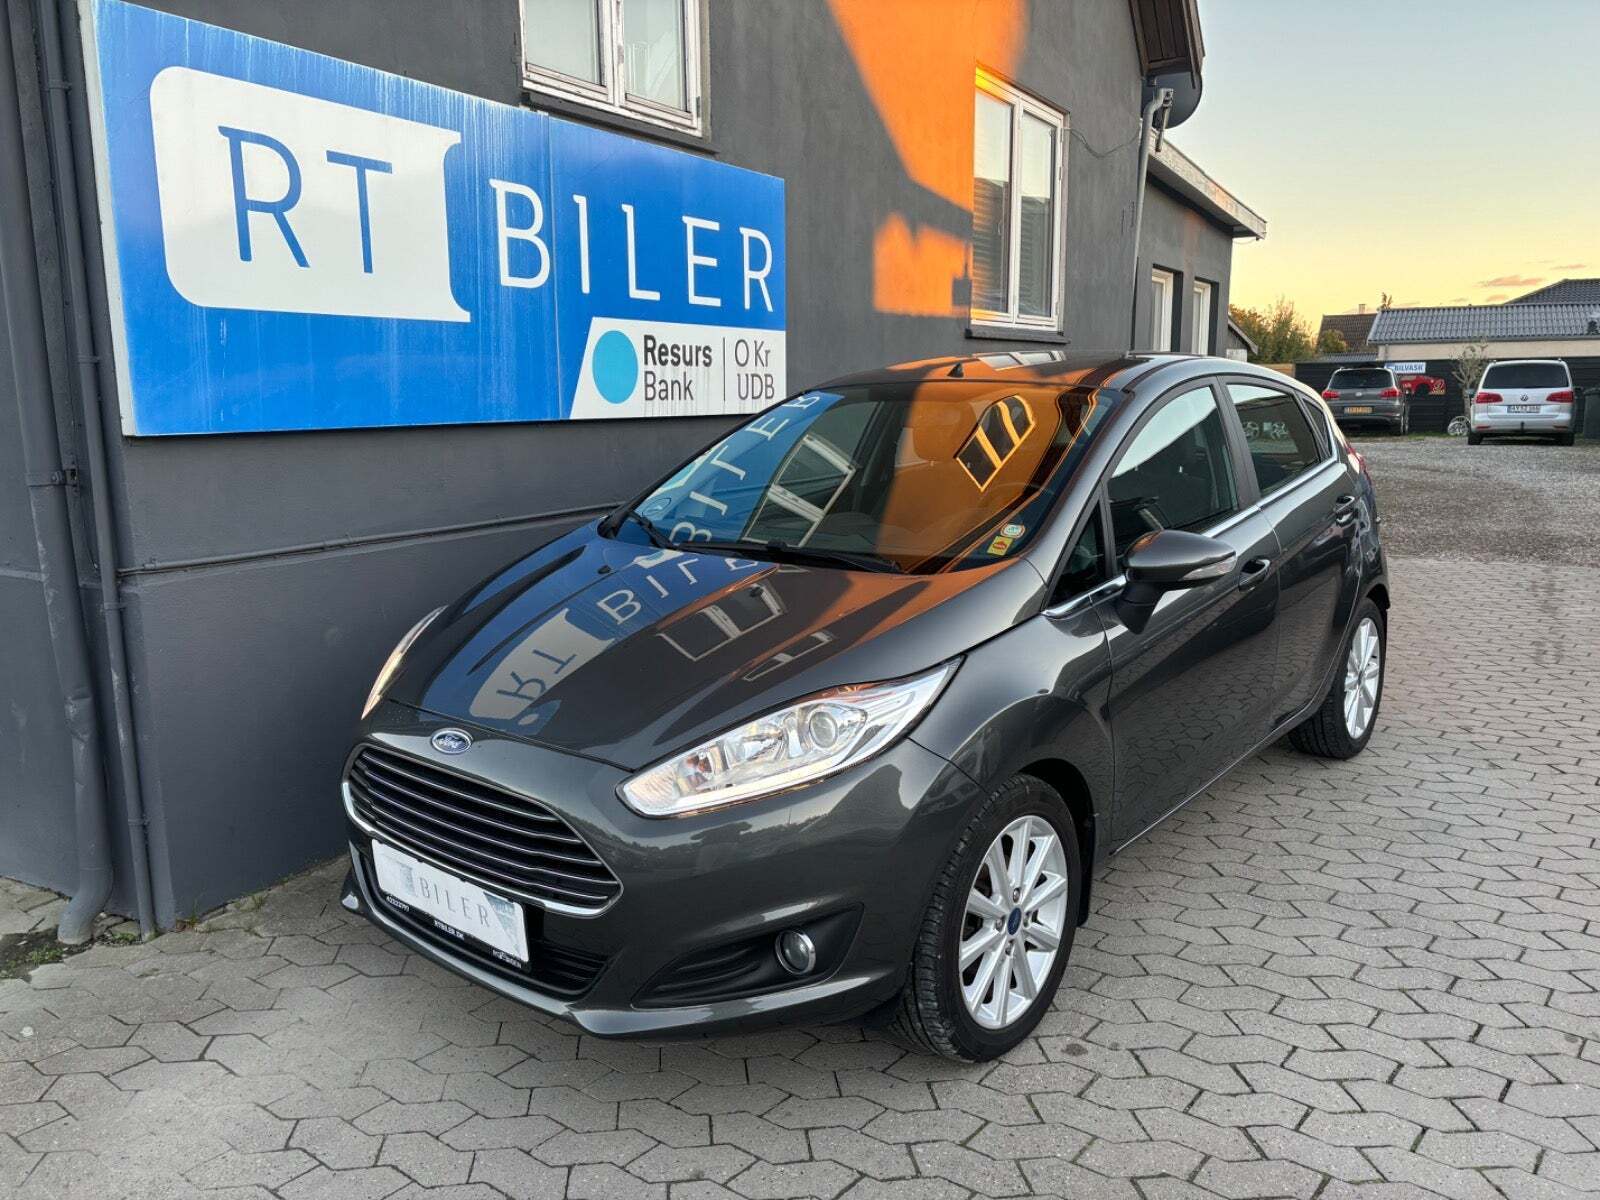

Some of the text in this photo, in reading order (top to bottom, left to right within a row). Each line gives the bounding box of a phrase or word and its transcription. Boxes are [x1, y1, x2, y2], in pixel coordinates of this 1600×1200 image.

[218, 125, 775, 312] RT BILER
[643, 334, 713, 368] Resurs
[753, 339, 771, 368] Kr
[644, 371, 694, 402] Bank
[737, 373, 774, 401] UDB
[420, 877, 490, 928] BILER
